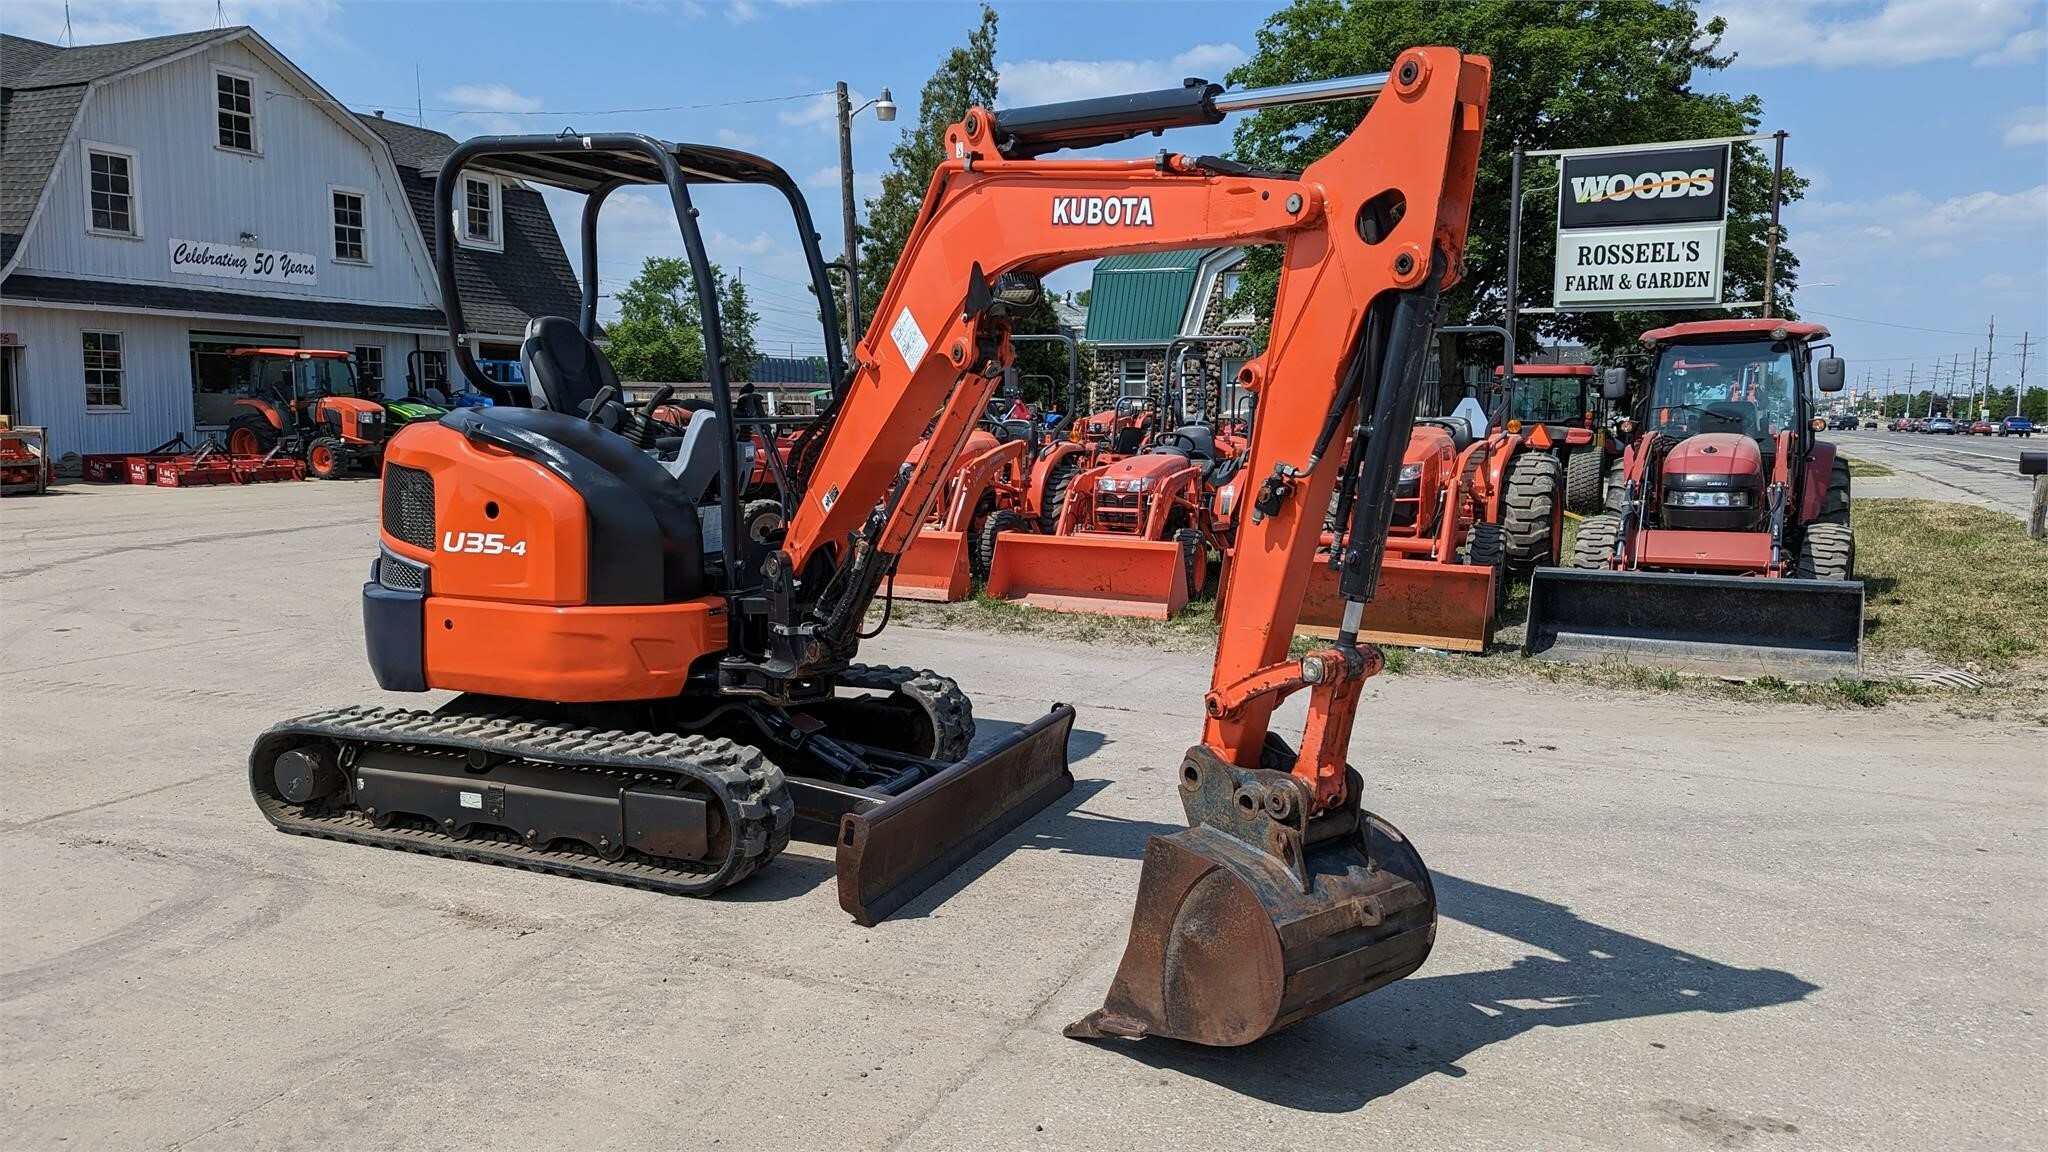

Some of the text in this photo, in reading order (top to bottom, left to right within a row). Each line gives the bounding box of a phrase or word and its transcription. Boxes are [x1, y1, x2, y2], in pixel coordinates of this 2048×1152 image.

[1571, 168, 1715, 203] WOODS
[1052, 196, 1154, 226] KUBOTA
[173, 243, 315, 278] Celebrating 50 Years
[1577, 240, 1700, 266] ROSSEEL'S
[1565, 271, 1710, 291] FARM & GARDEN
[131, 464, 145, 474] LMC
[159, 467, 176, 479] LMC
[443, 531, 526, 556] U35-4
